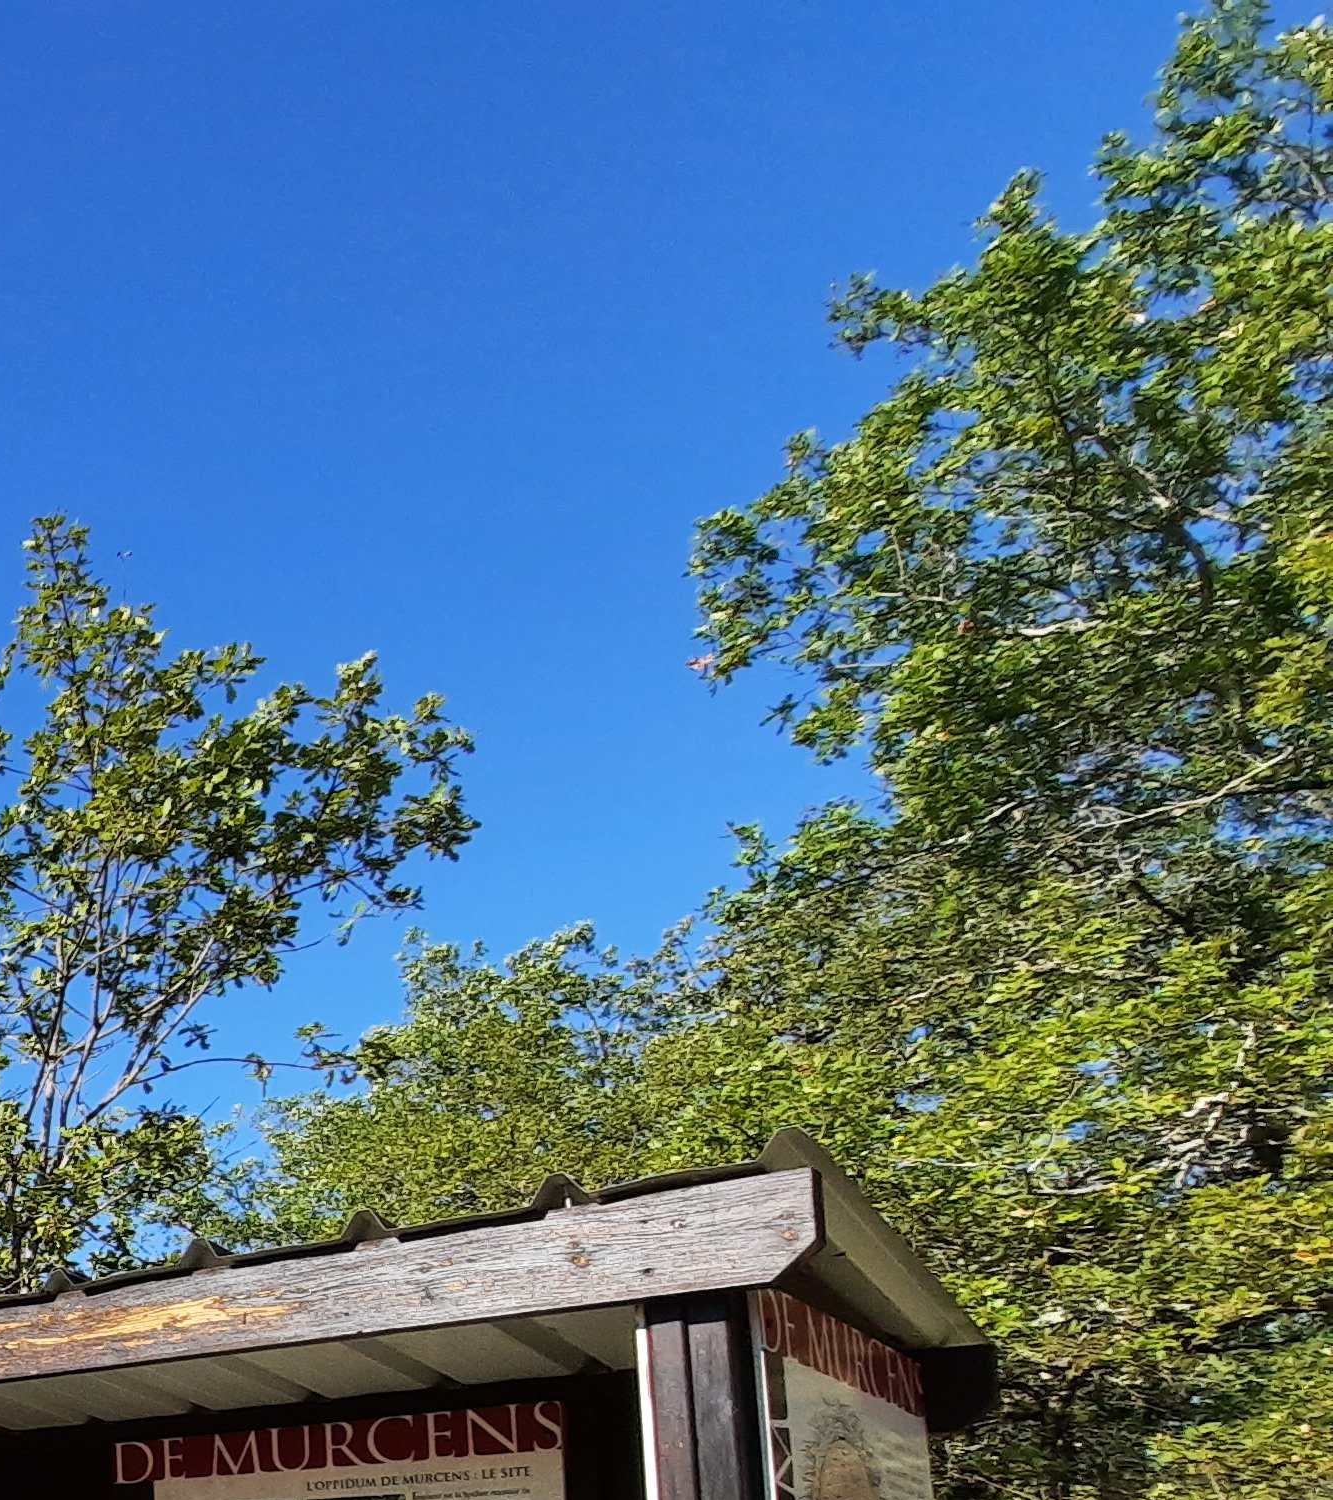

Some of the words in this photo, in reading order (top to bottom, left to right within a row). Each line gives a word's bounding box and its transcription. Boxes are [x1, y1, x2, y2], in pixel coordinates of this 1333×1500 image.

[113, 1438, 187, 1485] DE
[211, 1400, 564, 1477] MURCENS
[382, 1475, 400, 1486] DE
[402, 1470, 469, 1484] MURCENS
[482, 1469, 496, 1478] LE
[500, 1466, 530, 1477] SITE
